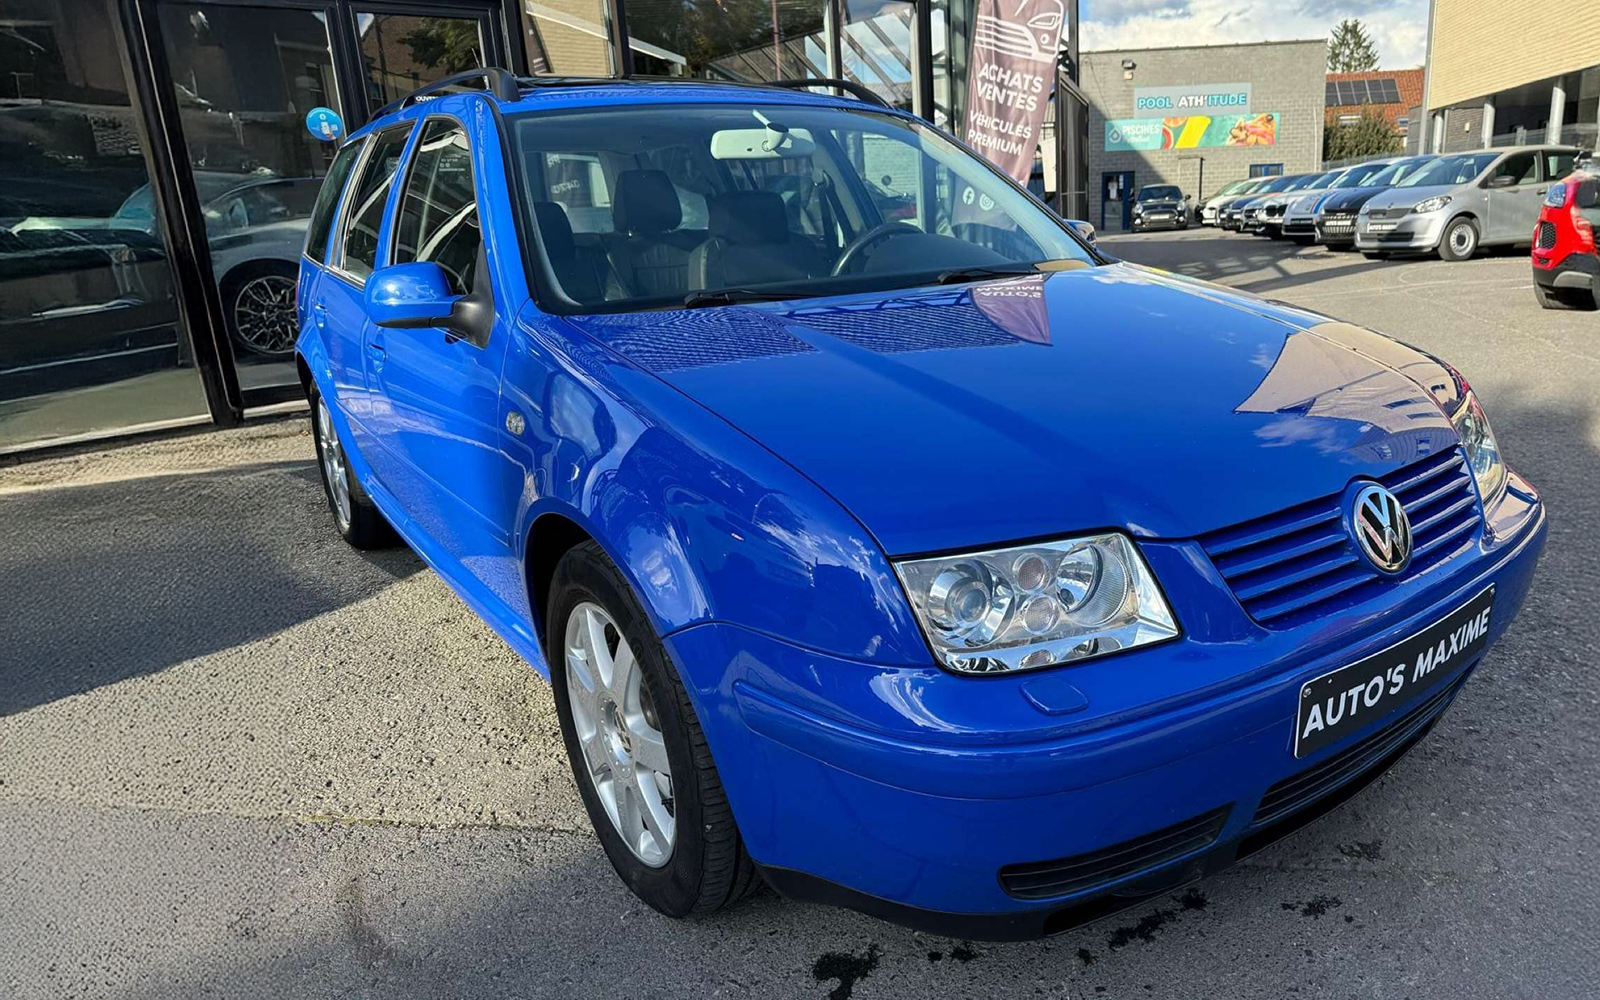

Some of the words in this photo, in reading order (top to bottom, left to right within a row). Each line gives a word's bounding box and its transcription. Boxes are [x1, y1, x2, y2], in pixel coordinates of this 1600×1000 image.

[979, 63, 1044, 94] ACHATS
[977, 81, 1038, 112] VENTES
[1137, 97, 1172, 110] POOL
[1178, 93, 1246, 108] ATH'ITUDE
[968, 129, 1022, 156] PREMIUM
[1121, 124, 1160, 135] PISCINES
[1302, 663, 1406, 739] AUTO'S
[1412, 606, 1491, 683] MAXIME
